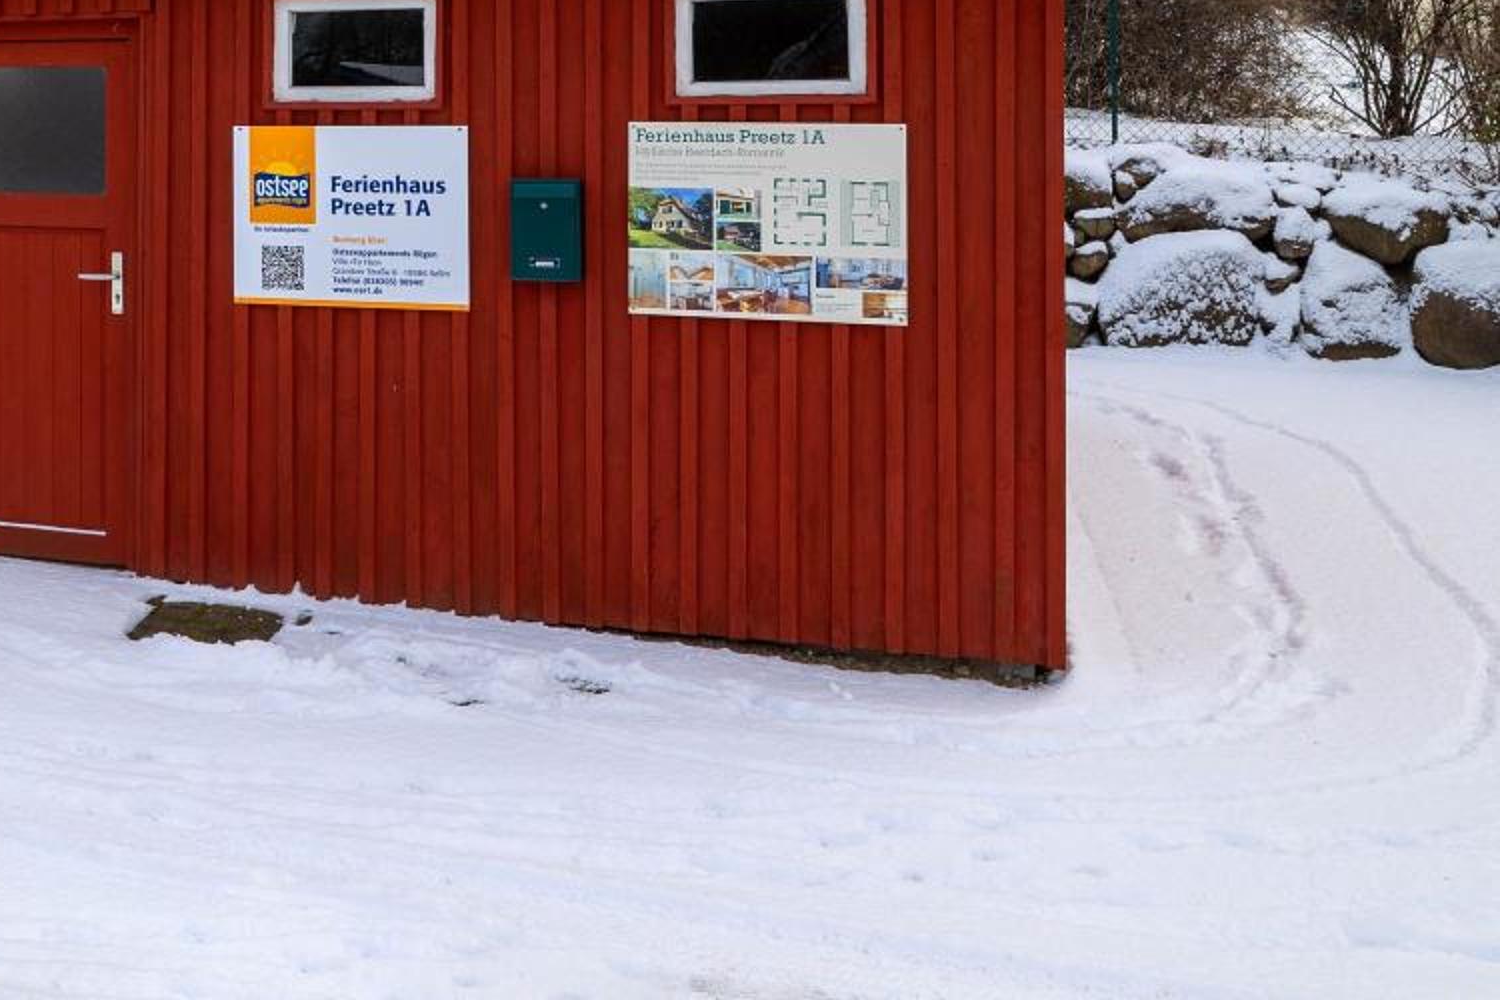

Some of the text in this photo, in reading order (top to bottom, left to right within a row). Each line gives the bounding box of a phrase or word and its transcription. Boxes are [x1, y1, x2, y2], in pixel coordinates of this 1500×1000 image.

[634, 127, 825, 145] Ferienhaus Preetz 1A
[256, 175, 308, 197] ostsee
[331, 176, 446, 194] Ferienhaus
[331, 199, 431, 216] Preetz 1A
